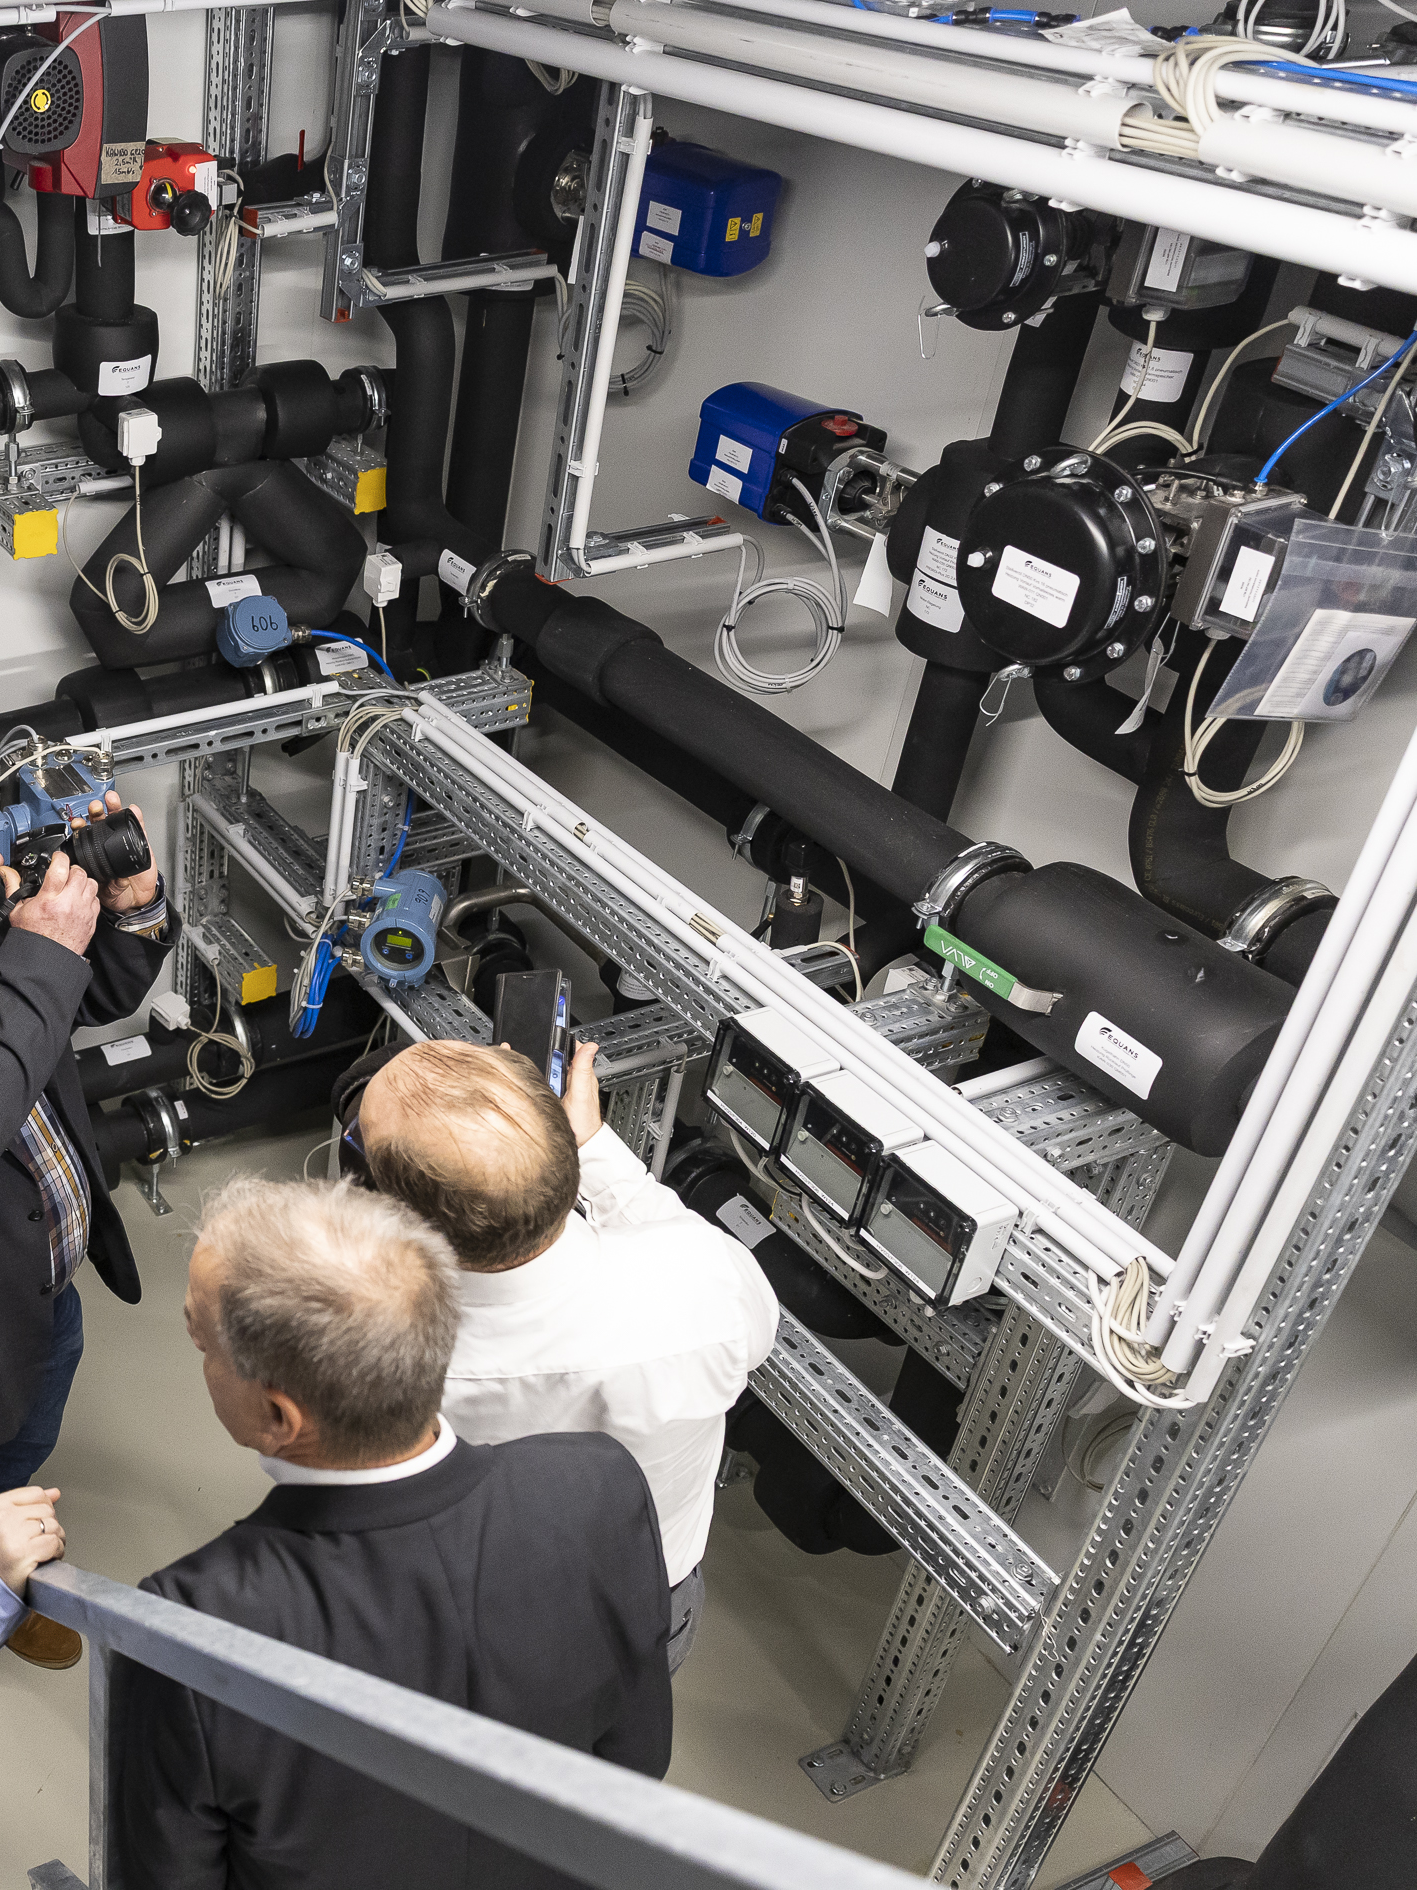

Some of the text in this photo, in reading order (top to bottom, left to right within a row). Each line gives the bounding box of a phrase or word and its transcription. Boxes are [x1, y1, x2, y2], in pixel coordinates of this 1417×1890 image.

[940, 542, 959, 550] EQUAN
[1030, 564, 1052, 578] EQUANS
[923, 585, 948, 600] EQUANS
[985, 980, 994, 988] ON
[1108, 1034, 1138, 1059] EQUANS
[744, 1208, 762, 1225] EQUANS
